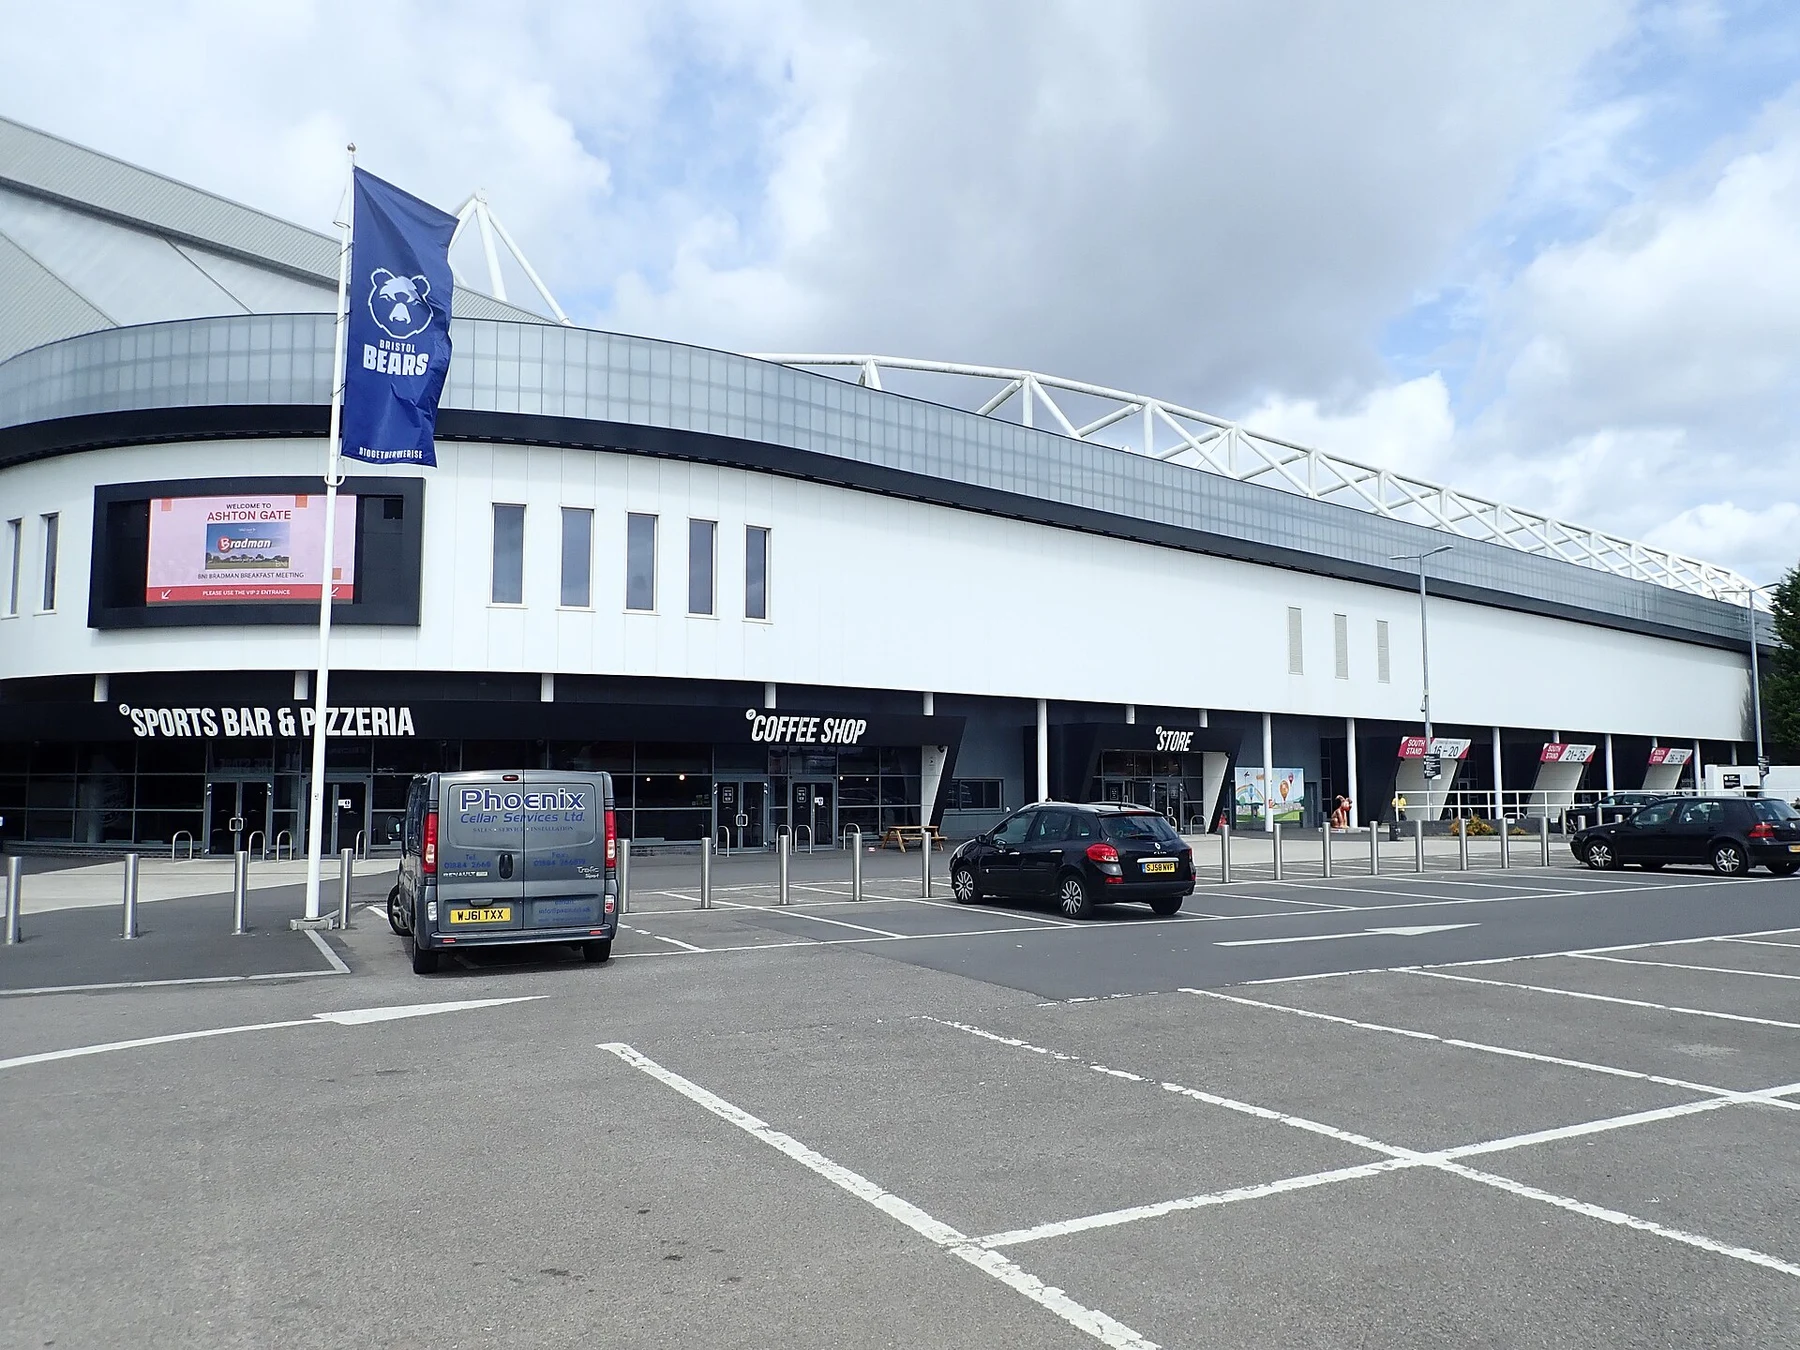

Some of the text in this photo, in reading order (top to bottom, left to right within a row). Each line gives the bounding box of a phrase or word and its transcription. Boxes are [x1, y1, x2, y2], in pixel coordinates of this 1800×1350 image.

[380, 339, 416, 354] BRISTOL
[363, 343, 429, 376] BEARS
[207, 510, 291, 521] ASHTON GATE
[219, 537, 272, 551] Bradman
[130, 707, 415, 737] SPORTS BAR & PZZERIA
[752, 715, 866, 744] COFFEE SHOP
[1156, 730, 1194, 752] STORE
[1408, 739, 1426, 747] SOUTH
[459, 788, 585, 812] Phoenix
[460, 812, 585, 823] Cellar Services Ltd.
[458, 909, 504, 921] WJ61 TXX
